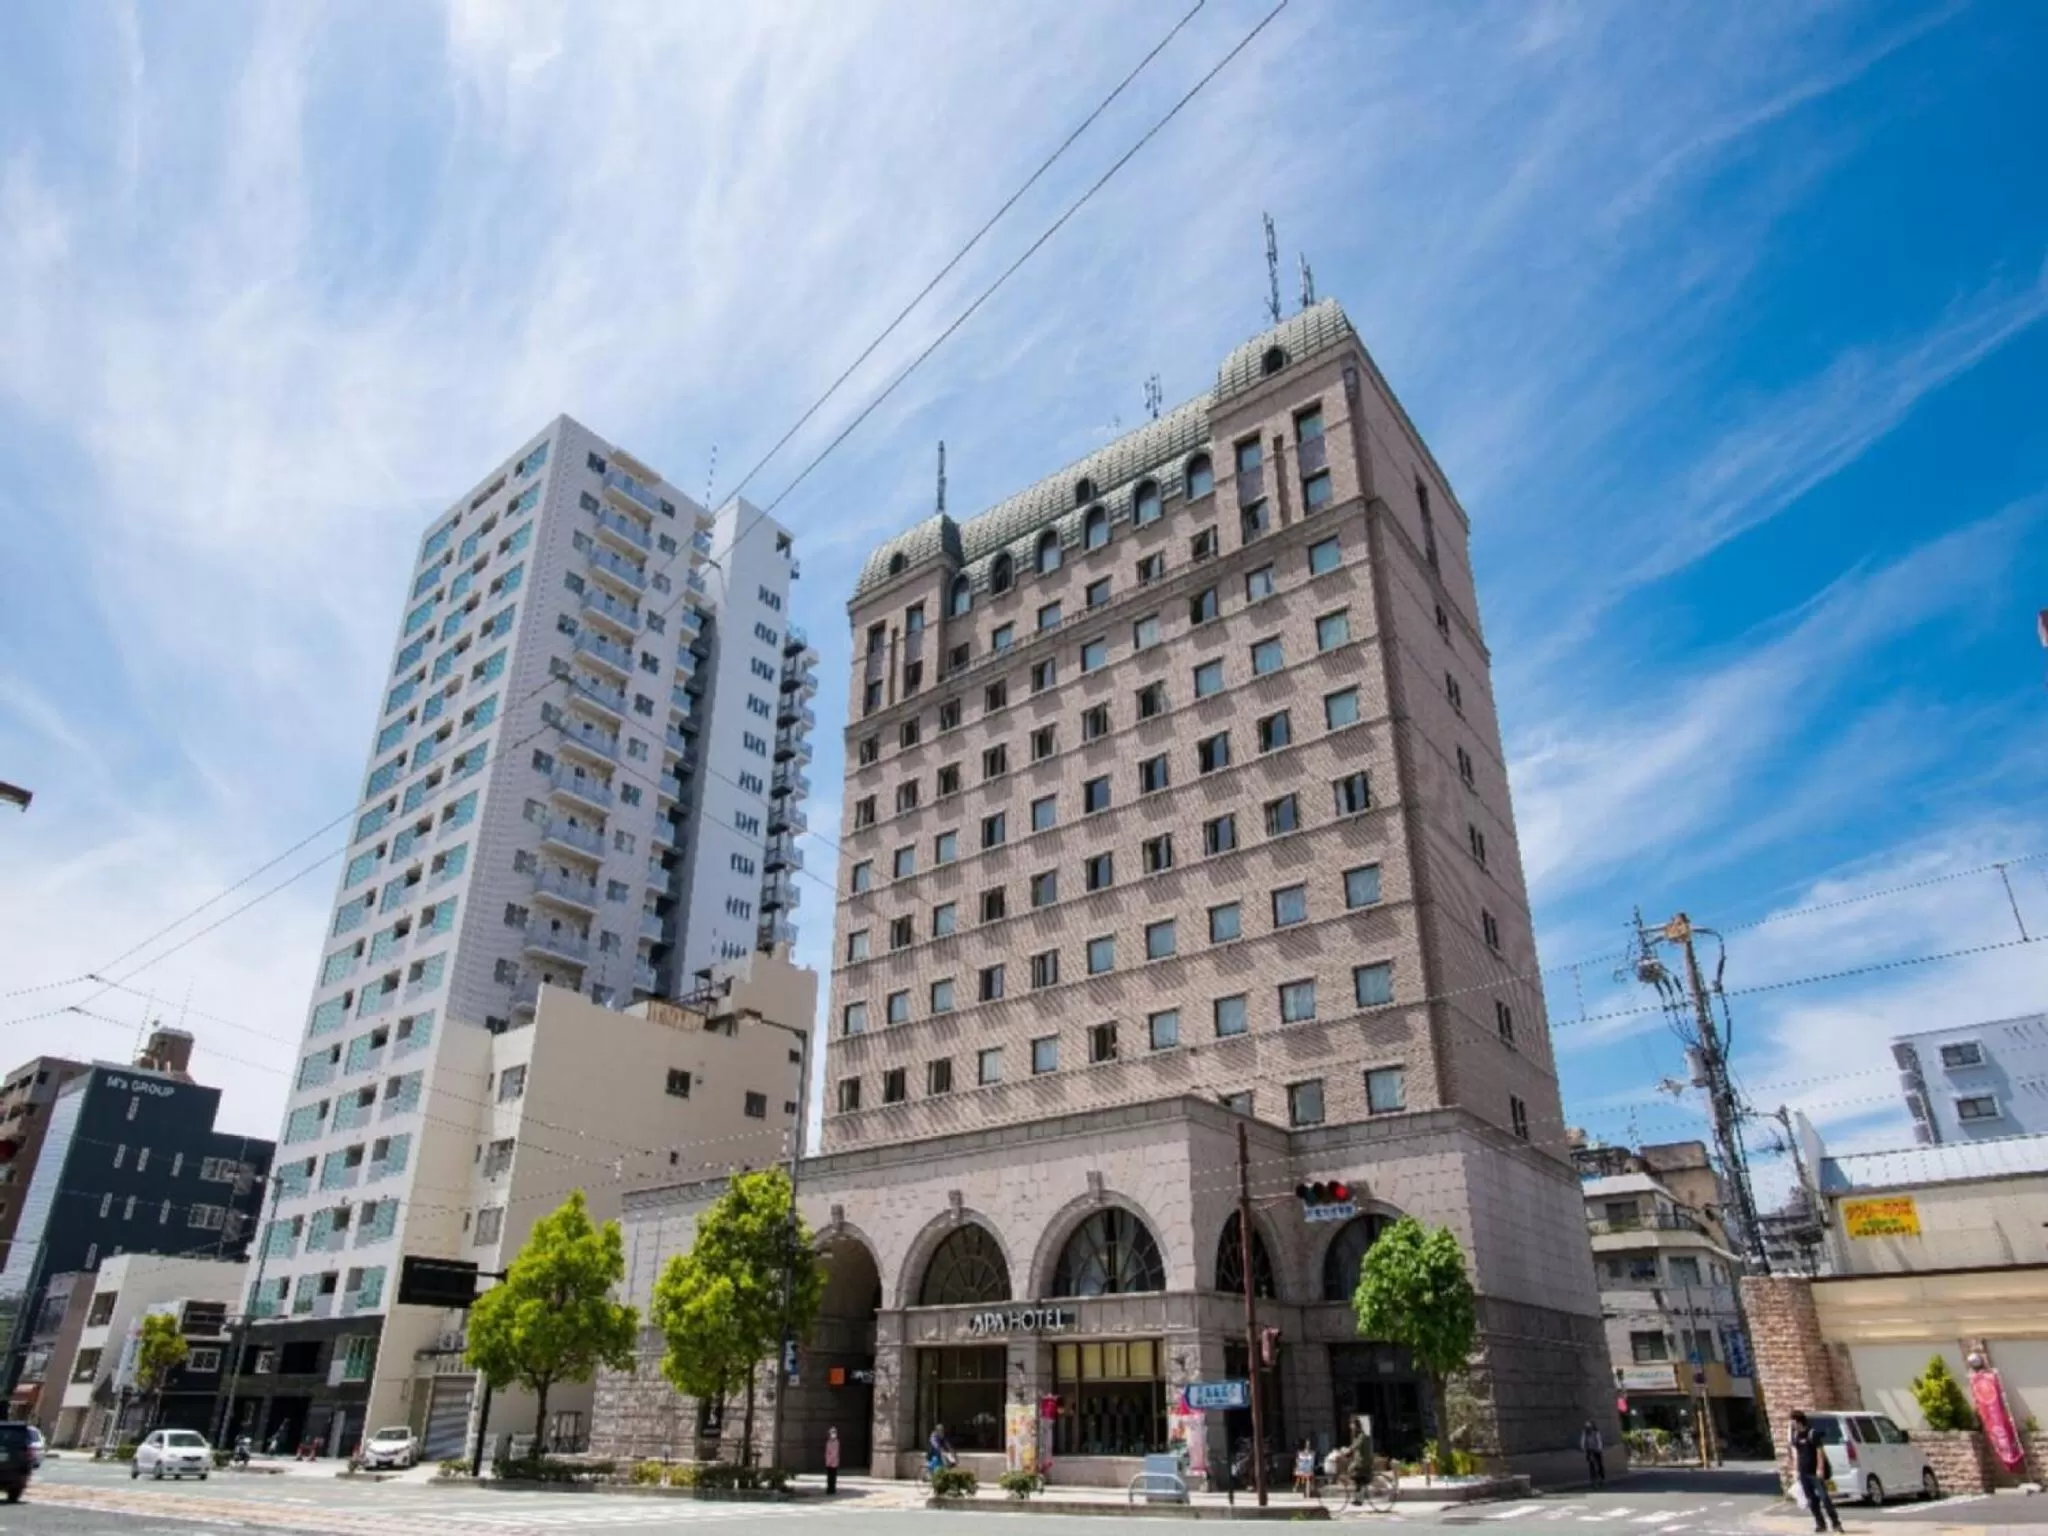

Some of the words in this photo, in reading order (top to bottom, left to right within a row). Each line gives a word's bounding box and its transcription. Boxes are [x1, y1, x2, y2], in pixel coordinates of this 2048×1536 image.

[132, 1080, 175, 1097] GROUP
[972, 1312, 1005, 1333] APA
[1007, 1307, 1064, 1331] HOTEL
